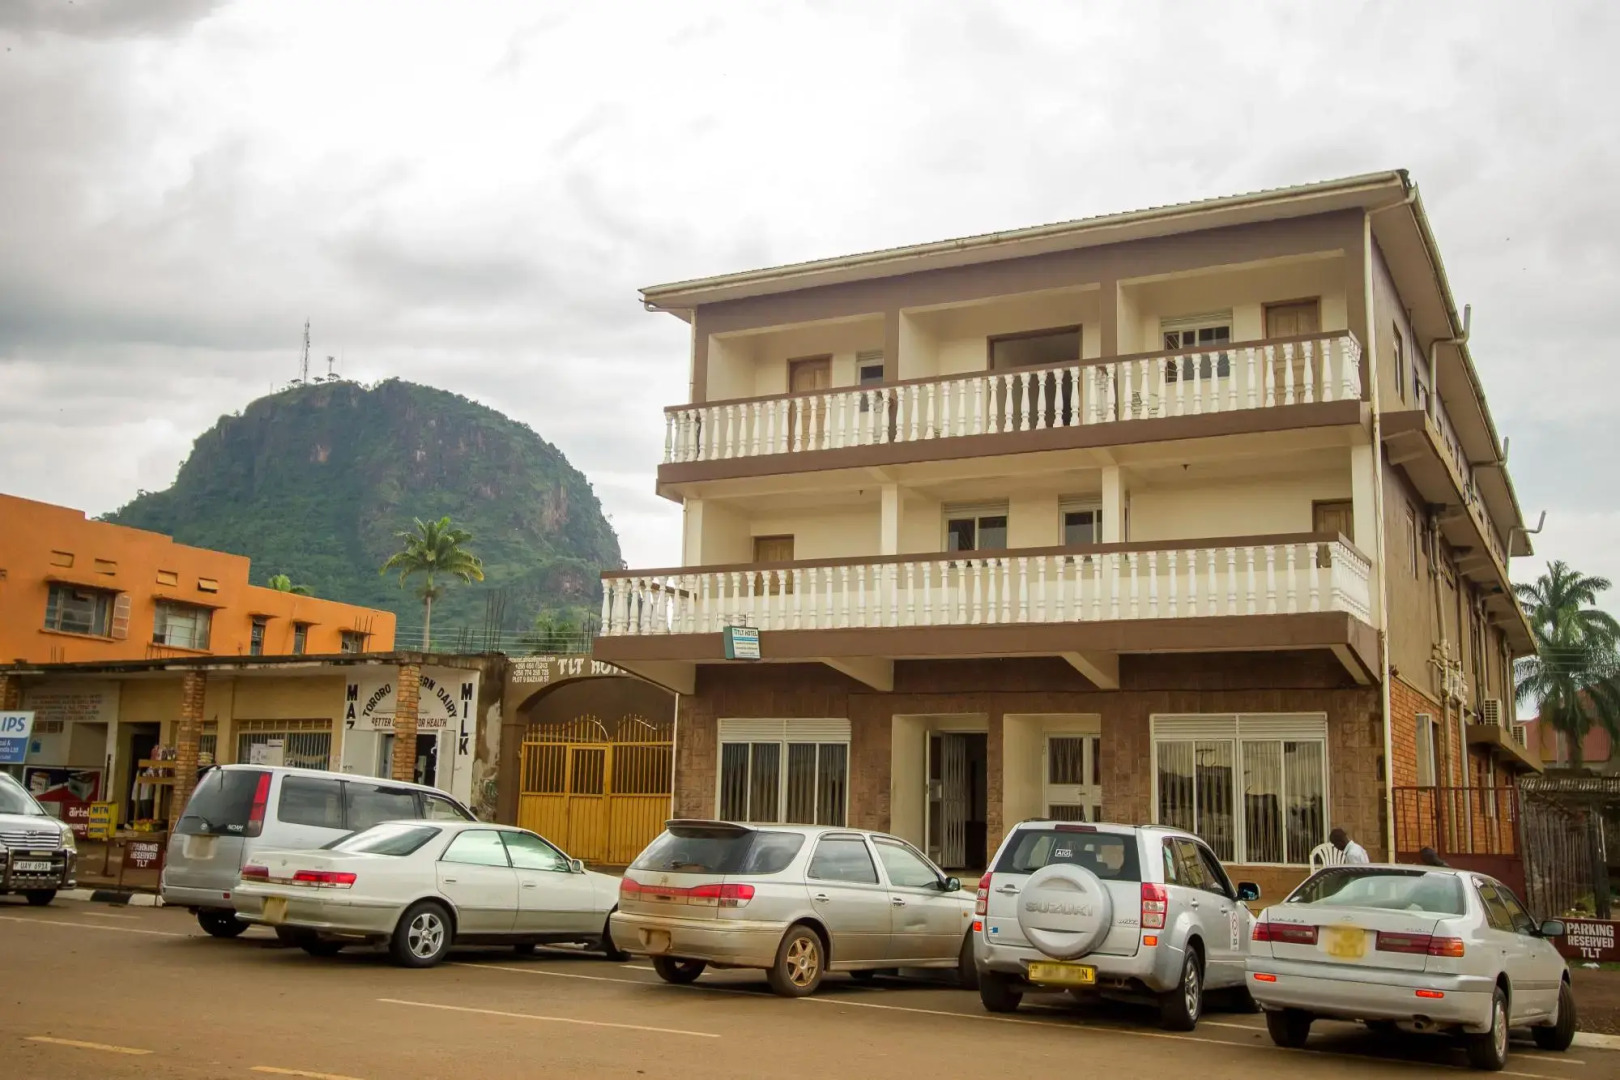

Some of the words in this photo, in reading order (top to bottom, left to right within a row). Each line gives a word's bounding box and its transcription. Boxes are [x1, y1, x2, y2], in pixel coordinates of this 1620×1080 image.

[558, 658, 585, 675] TLT
[591, 659, 627, 674] HO
[362, 684, 392, 717] TORORO
[436, 687, 458, 718] DAIRY
[426, 718, 448, 728] HEALTH
[458, 683, 473, 756] MILK
[68, 806, 90, 818] airtel
[136, 860, 148, 868] TLT
[1025, 902, 1094, 916] SUZUKI
[1566, 922, 1614, 936] PARKING
[1568, 935, 1614, 948] RESERVED
[1580, 947, 1602, 958] TLT
